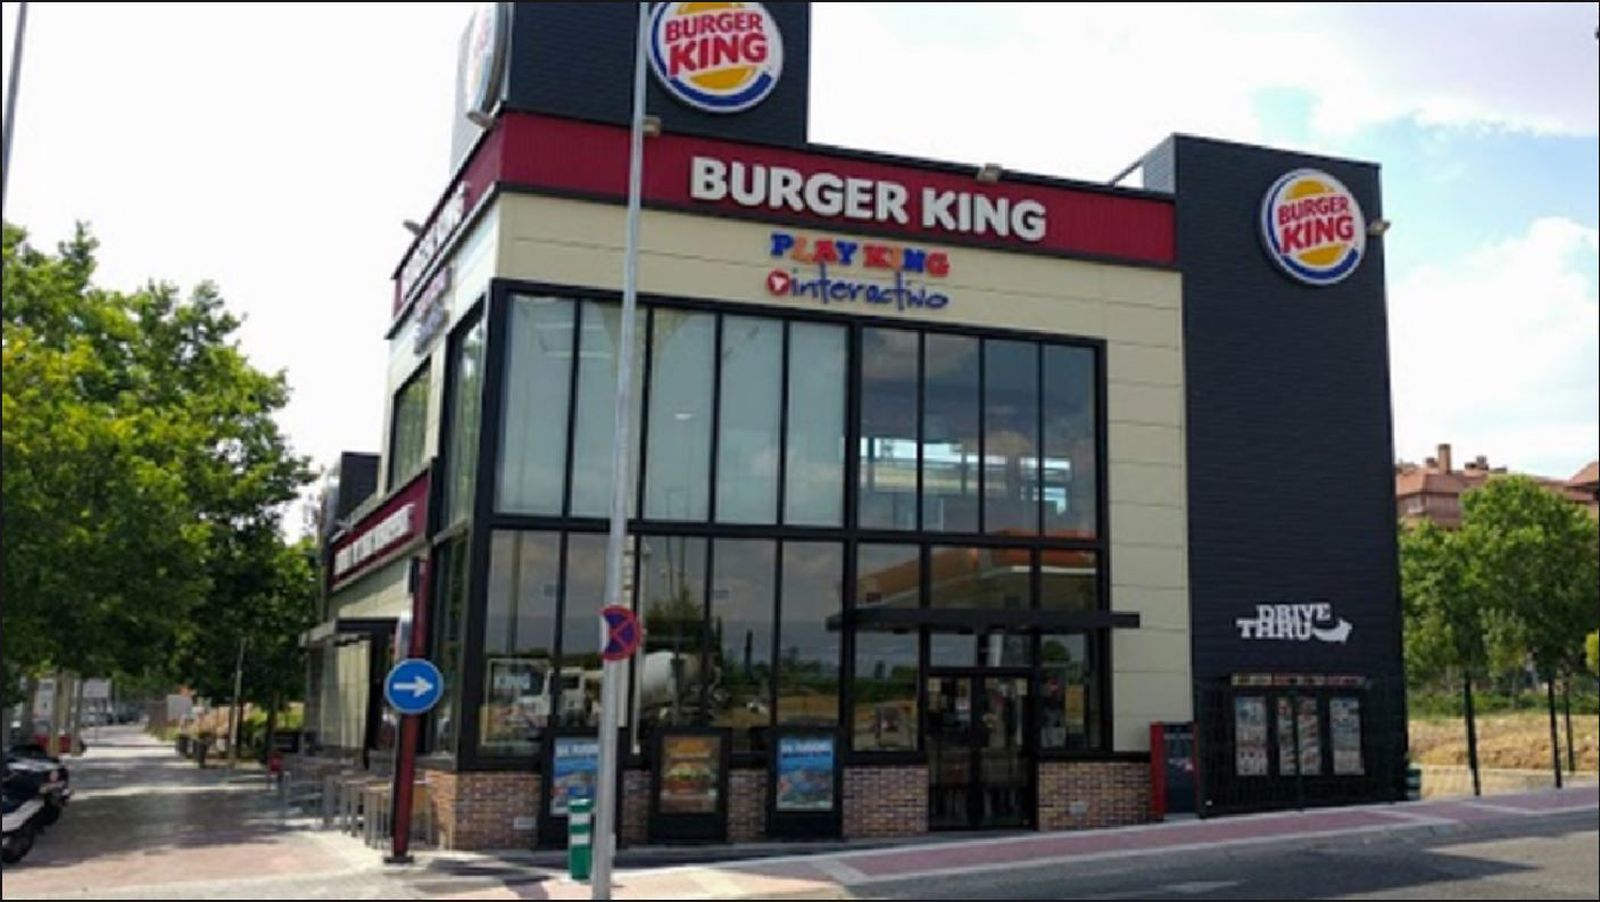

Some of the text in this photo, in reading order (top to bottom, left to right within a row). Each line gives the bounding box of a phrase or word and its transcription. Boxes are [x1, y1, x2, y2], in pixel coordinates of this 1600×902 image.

[665, 11, 763, 44] BURGER
[669, 32, 768, 76] KING
[691, 156, 1047, 242] BURGER KING
[1277, 196, 1350, 225] BURGER
[1282, 215, 1354, 254] KING
[770, 233, 950, 278] PLAY KING
[791, 262, 949, 311] interactivo
[1236, 618, 1312, 640] THRU
[1256, 602, 1331, 621] DRIVE
